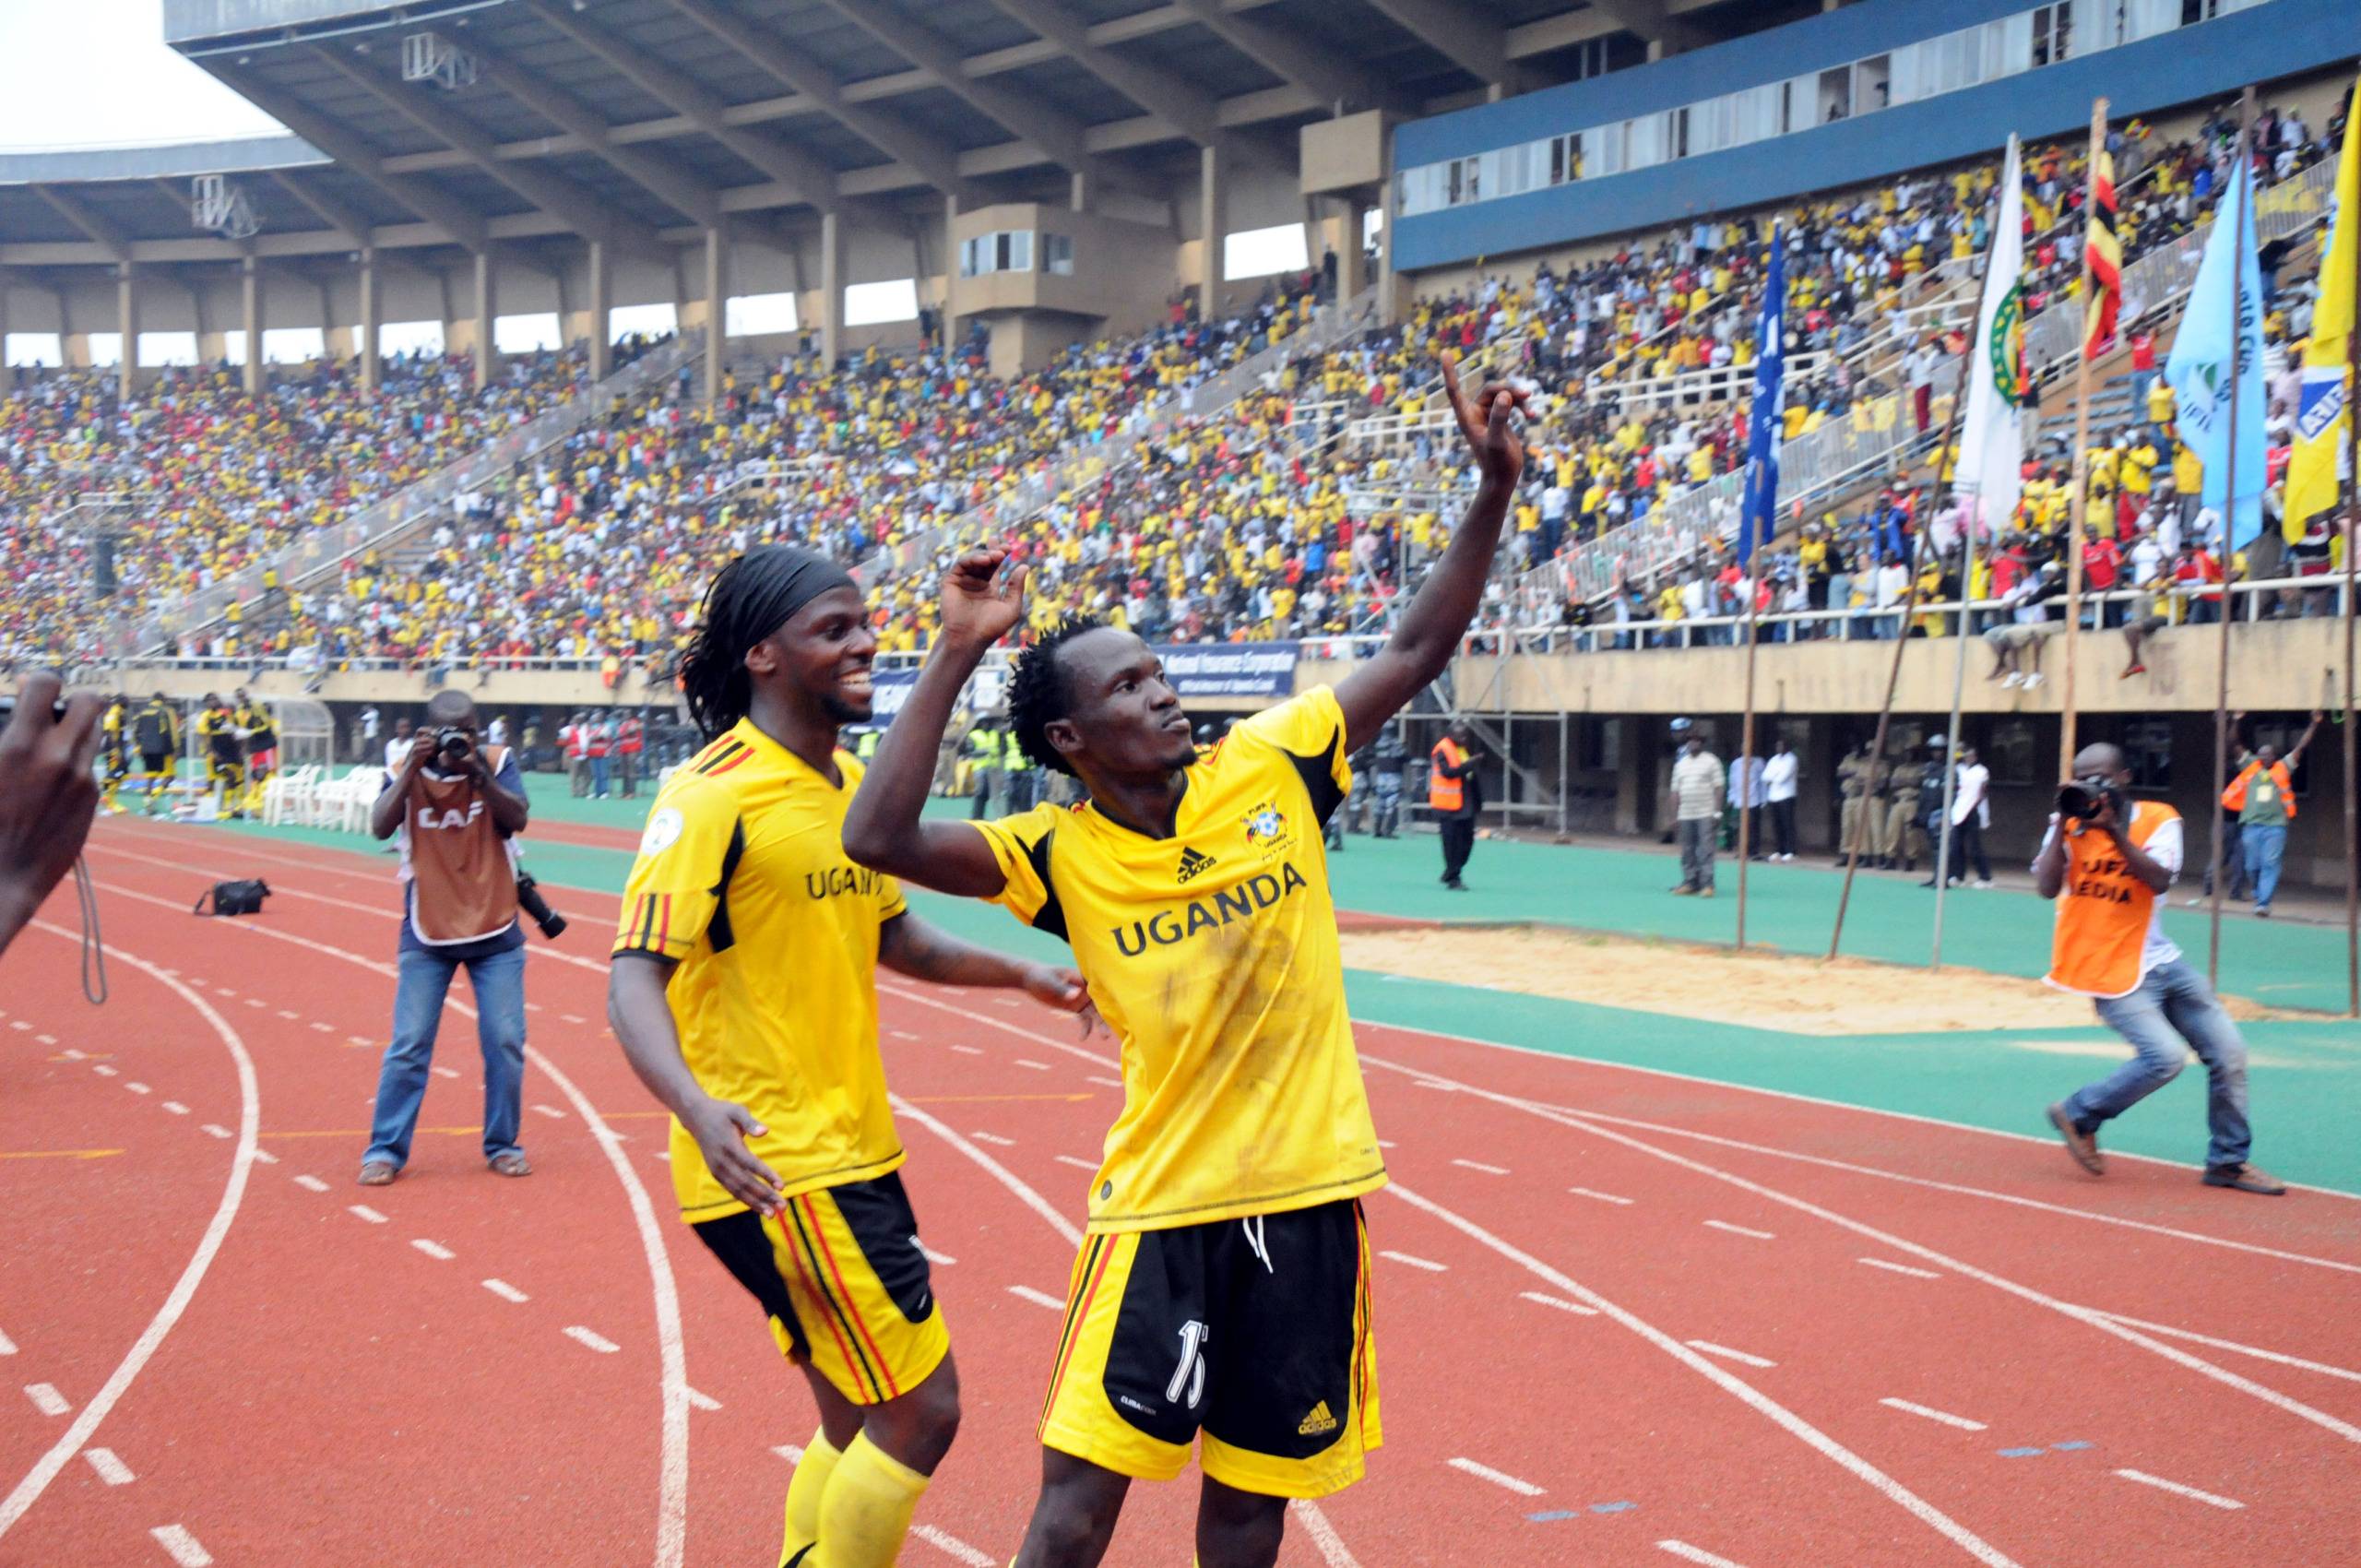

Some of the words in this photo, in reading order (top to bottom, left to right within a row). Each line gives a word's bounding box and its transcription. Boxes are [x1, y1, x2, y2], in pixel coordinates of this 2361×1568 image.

[1178, 856, 1216, 885] adidas
[2078, 881, 2131, 903] EDIA
[1111, 861, 1307, 957] UGANDA
[1299, 1418, 1336, 1435] adidas
